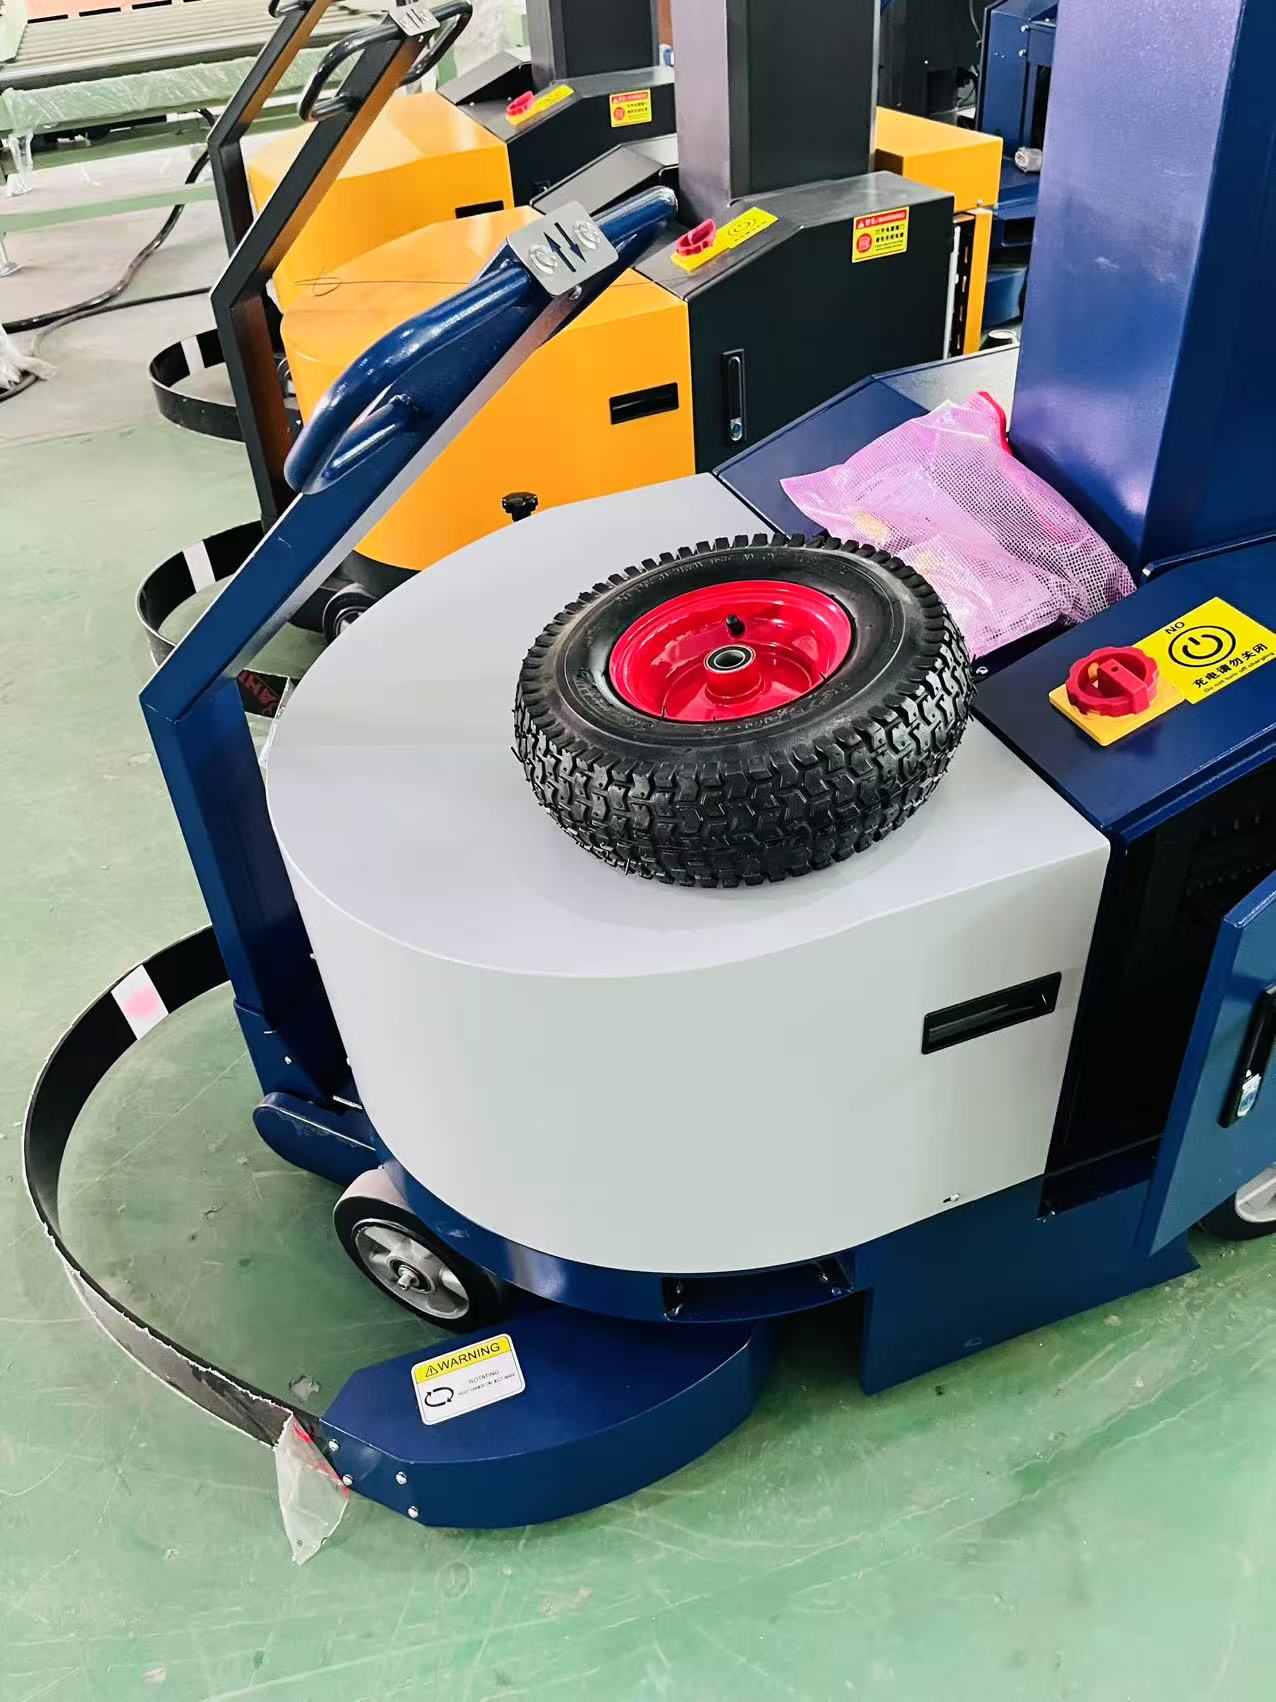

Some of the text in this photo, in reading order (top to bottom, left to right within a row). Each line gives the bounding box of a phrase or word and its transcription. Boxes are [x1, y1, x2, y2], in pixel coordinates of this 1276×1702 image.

[1164, 621, 1186, 635] NO
[1192, 643, 1268, 688] 充电请勿关闭
[437, 1342, 501, 1371] WARNING
